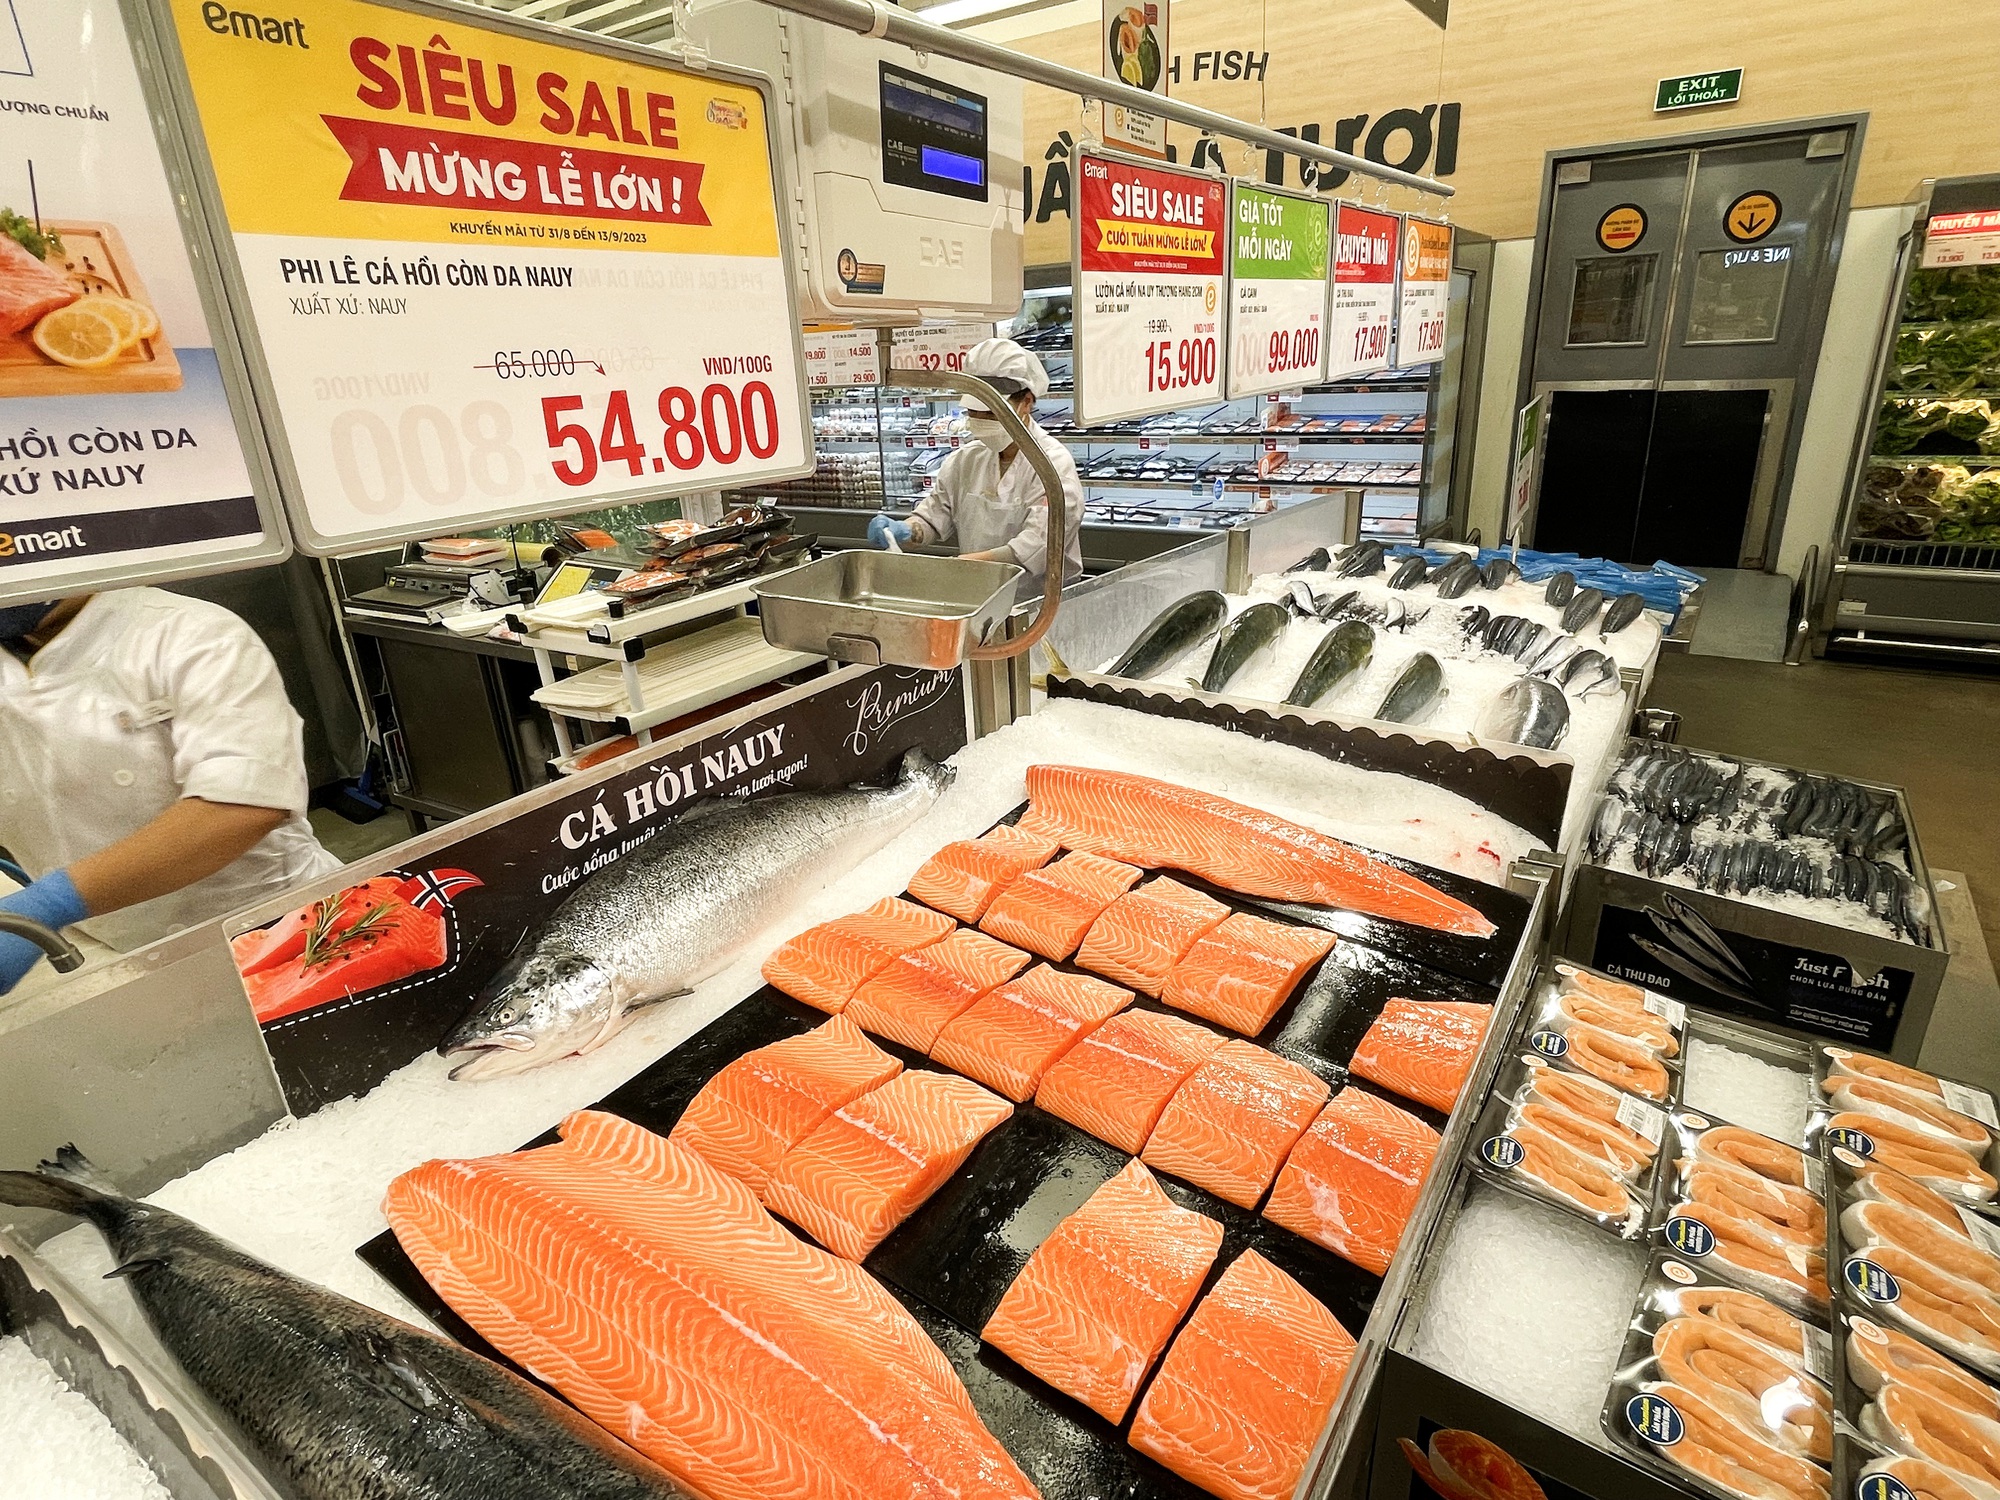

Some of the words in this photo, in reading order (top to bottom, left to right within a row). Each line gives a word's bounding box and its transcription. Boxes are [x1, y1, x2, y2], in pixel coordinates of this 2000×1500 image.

[203, 1, 310, 49] emart
[1193, 50, 1270, 82] FISH
[349, 34, 517, 126] SIÊU
[537, 72, 680, 150] SALE
[1668, 92, 1685, 105] LỐI
[1688, 87, 1727, 102] THOÁT
[1678, 75, 1721, 92] EXIT
[0, 100, 51, 116] ƯỢNG
[55, 104, 110, 121] CHUẨN
[887, 138, 904, 152] CAS
[378, 142, 527, 201] MỪNG
[537, 151, 585, 207] LỄ
[592, 164, 664, 213] LỚN
[1084, 161, 1109, 180] emart
[1111, 178, 1158, 220] SIÊU
[1162, 190, 1204, 225] SALE
[1239, 197, 1260, 225] GIÁ
[1262, 196, 1283, 227] TỐT
[450, 222, 502, 236] KHUYẾN
[505, 225, 528, 237] MÃI
[530, 224, 546, 237] TỪ
[549, 227, 571, 239] 31/8
[573, 227, 596, 240] ĐẾN
[598, 230, 648, 243] 13/9/2023
[1931, 214, 1981, 230] KHUYẾN
[920, 235, 964, 270] CAS
[1106, 226, 1129, 247] CUỐI
[1156, 231, 1179, 250] MỪNG
[1239, 227, 1262, 259] MỖI
[1264, 238, 1293, 262] NGÀY
[1336, 225, 1372, 264] KHUYẾN
[1373, 233, 1388, 265] MÃI
[279, 257, 325, 285] PHI
[329, 254, 361, 285] LÊ
[365, 256, 399, 286] CÁ
[403, 255, 440, 287] HỒI
[446, 258, 489, 287] CÒN
[494, 266, 522, 288] DA
[525, 266, 574, 288] NAUY
[288, 291, 332, 315] XUẤT
[336, 292, 365, 315] XỨ:
[369, 298, 407, 316] NAUY
[1116, 282, 1125, 298] CÁ
[1138, 285, 1146, 298] NA
[1146, 285, 1155, 298] UY
[1148, 318, 1168, 334] 19.900
[1417, 319, 1444, 352] 17.900
[1268, 327, 1319, 374] 99.000
[1354, 324, 1387, 362] 17.900
[494, 348, 576, 380] 65.000
[703, 355, 773, 377] VND/100G
[1145, 337, 1215, 393] 15.900
[68, 426, 144, 456] CÒN
[151, 428, 197, 450] DA
[541, 380, 780, 487] 54.800
[52, 463, 146, 491] NAUY
[777, 753, 808, 782] ngon!
[558, 788, 618, 850] CÁ
[623, 763, 698, 825] HỒI
[700, 723, 786, 789] NAUY
[541, 865, 581, 895] Cuộc
[1624, 967, 1646, 982] THU
[1647, 973, 1671, 988] ĐAO
[1795, 957, 1830, 976] Just
[1832, 966, 1890, 989] Fsh
